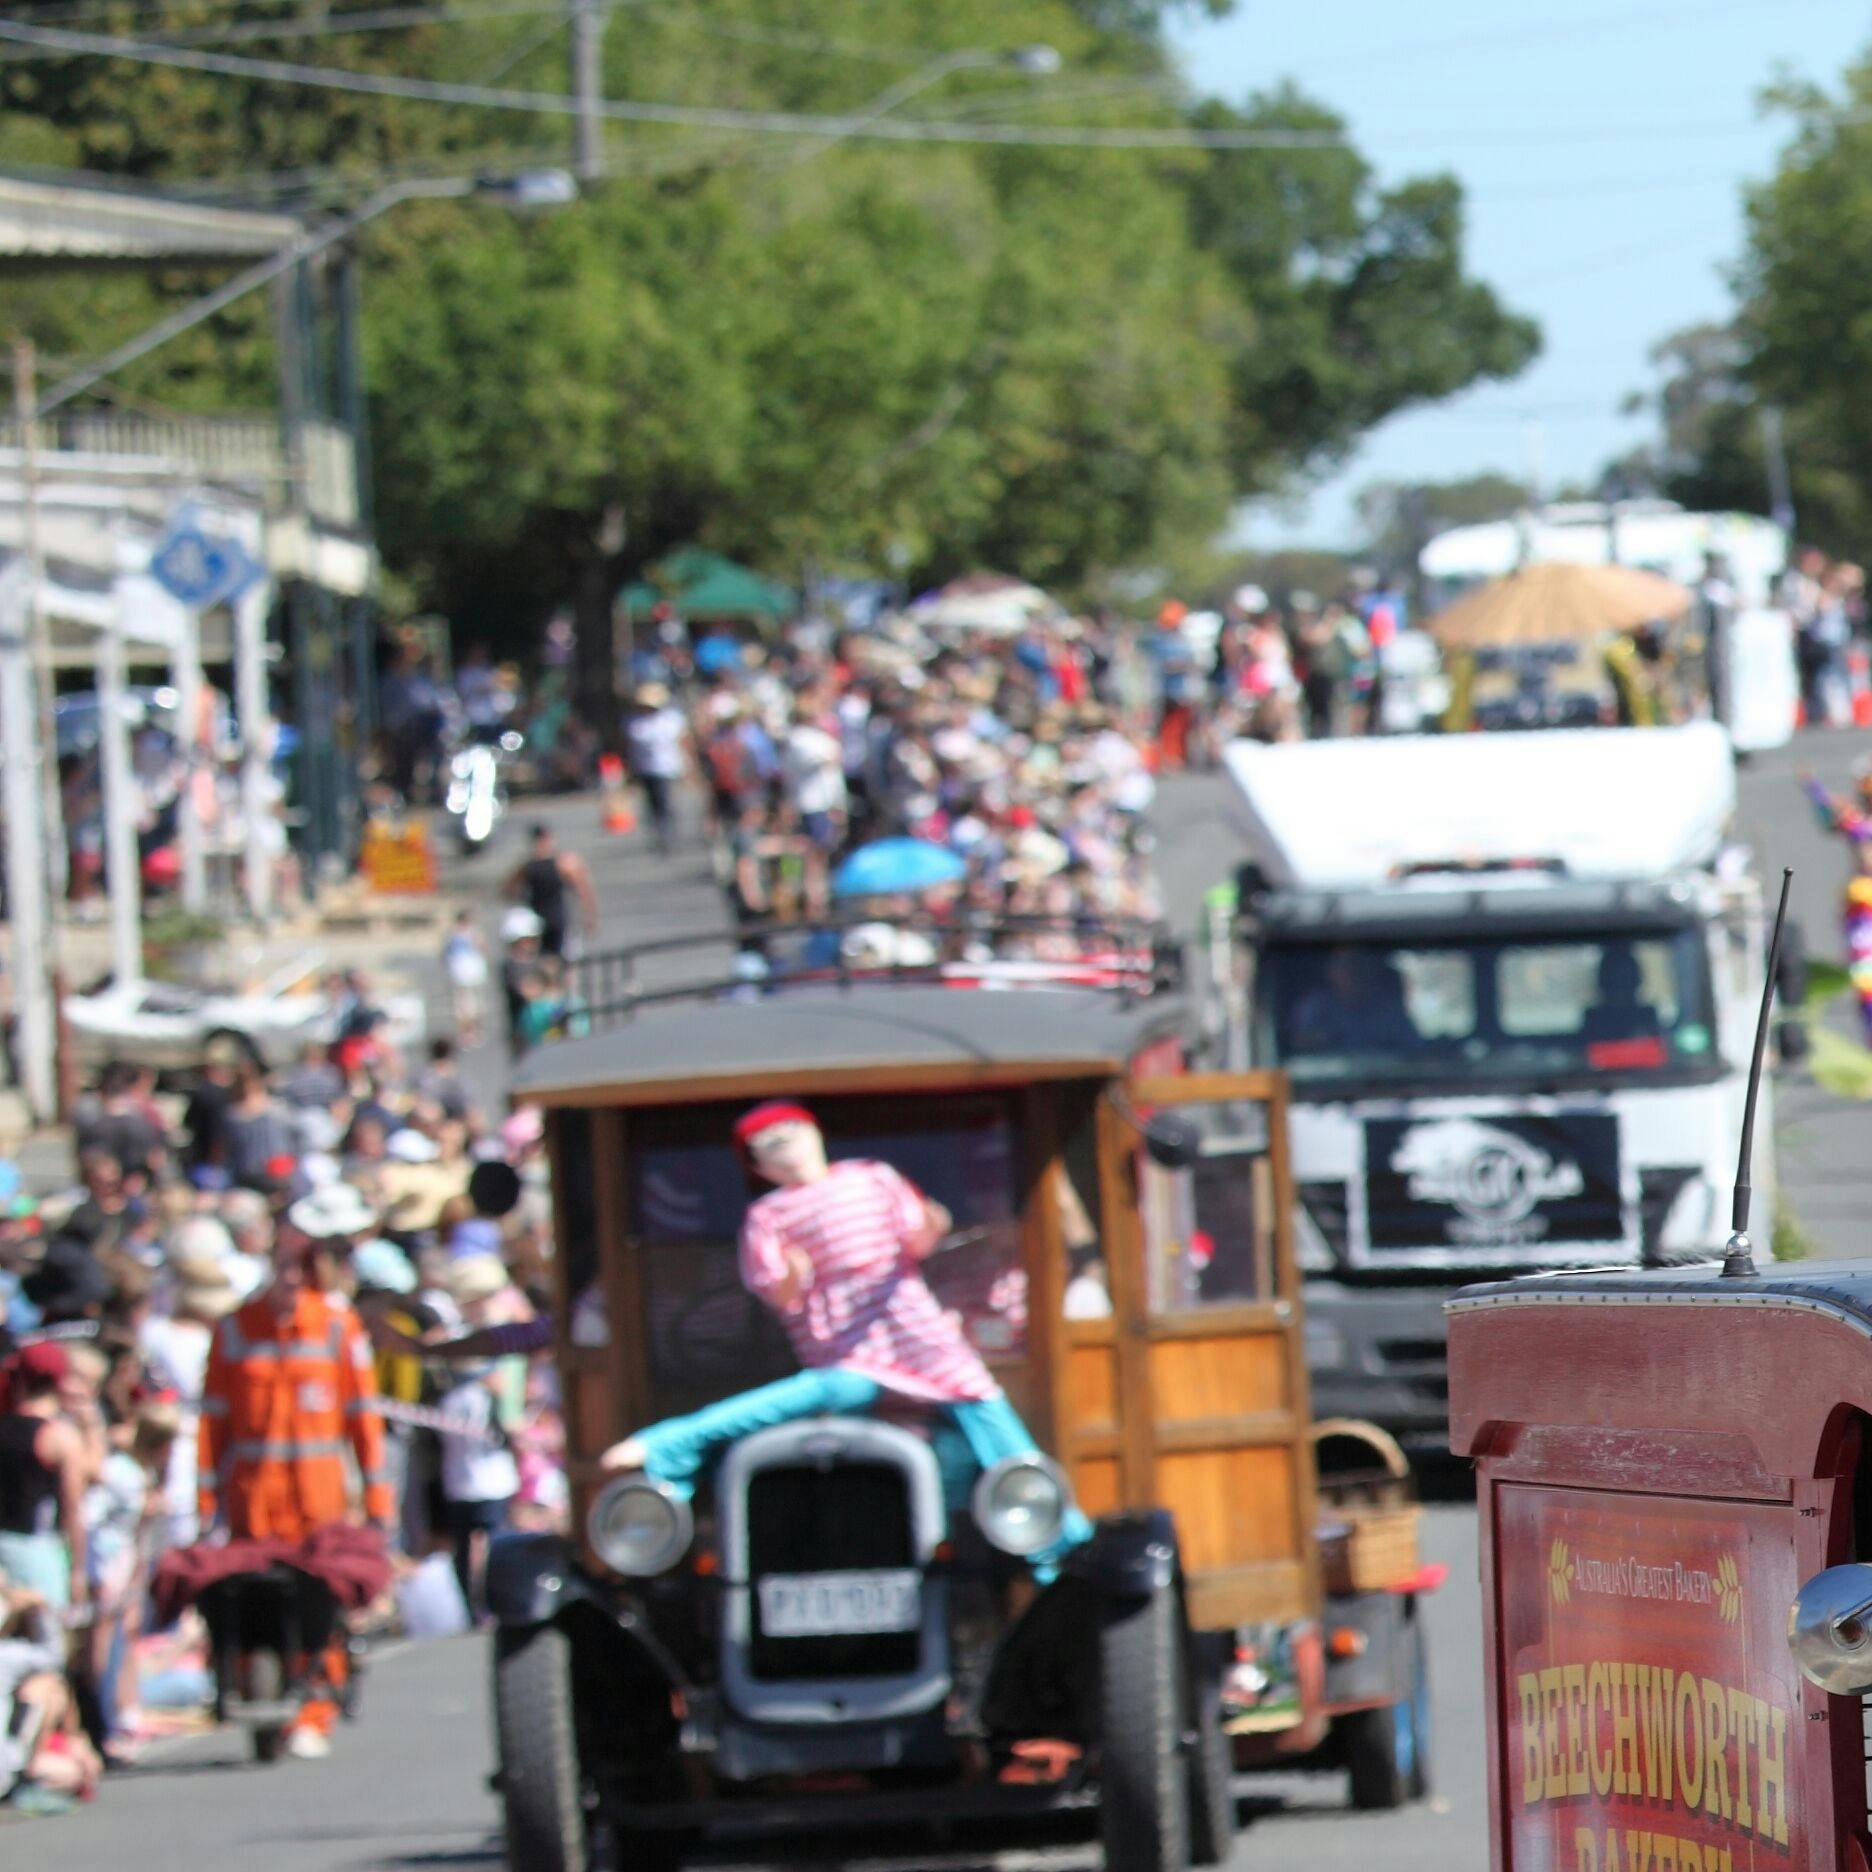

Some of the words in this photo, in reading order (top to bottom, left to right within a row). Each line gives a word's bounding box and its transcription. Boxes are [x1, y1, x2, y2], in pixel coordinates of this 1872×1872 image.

[1575, 1553, 1628, 1597] AUSTRALIA'S
[1628, 1556, 1674, 1600] GREATEST
[1674, 1561, 1713, 1605] BAKERY
[1517, 1661, 1789, 1848] BEECHWORTH
